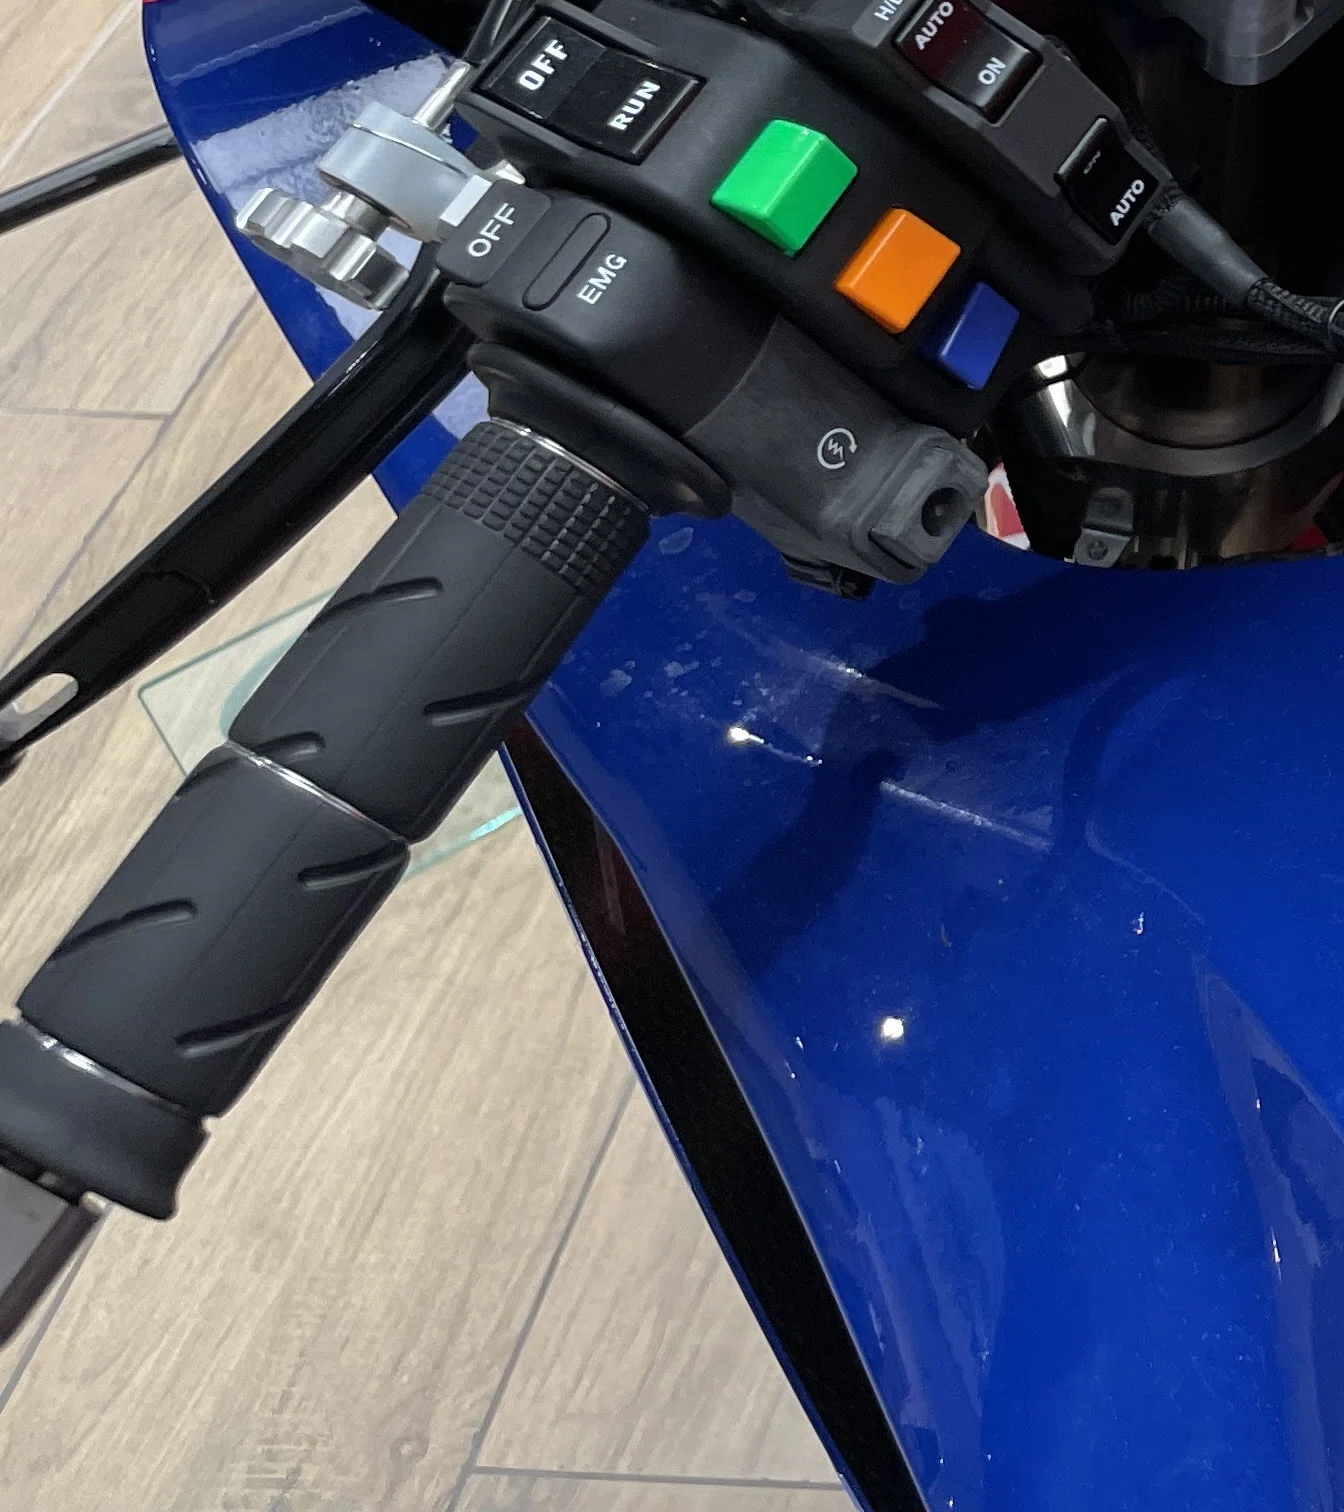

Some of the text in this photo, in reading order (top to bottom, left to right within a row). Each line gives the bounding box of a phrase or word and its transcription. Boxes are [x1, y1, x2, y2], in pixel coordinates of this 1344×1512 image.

[914, 1, 955, 50] AUTO
[519, 39, 569, 91] OFF
[977, 56, 1006, 85] ON
[607, 80, 661, 131] RUN
[1109, 179, 1145, 226] AUTO
[468, 202, 516, 257] OFF
[577, 253, 628, 305] EMG
